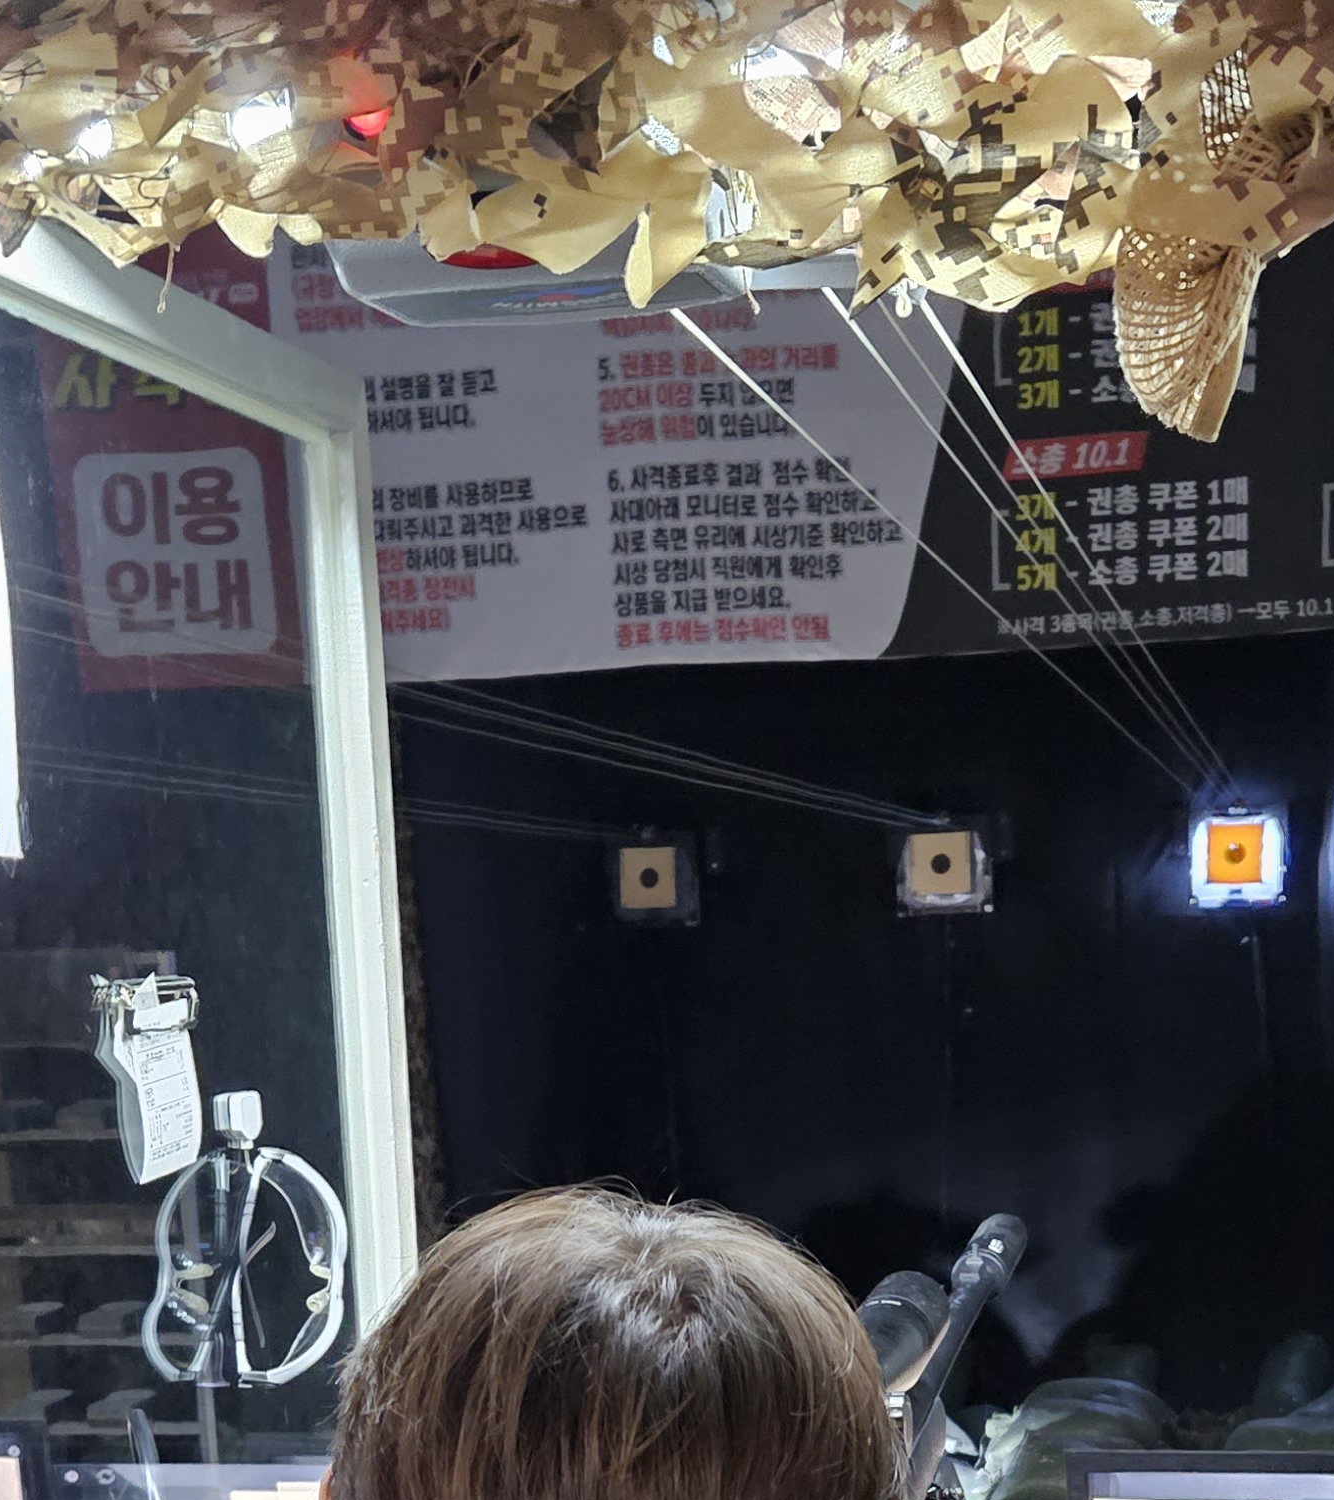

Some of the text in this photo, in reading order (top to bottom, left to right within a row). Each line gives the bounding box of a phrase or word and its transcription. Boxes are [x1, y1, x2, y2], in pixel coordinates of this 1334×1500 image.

[1018, 307, 1060, 337] 1개
[597, 357, 615, 381] 5.
[621, 350, 674, 379] 권총은
[783, 342, 839, 370] 거리를
[1017, 344, 1060, 374] 2개
[380, 372, 431, 401] 설명을
[437, 370, 454, 397] 잘
[462, 368, 498, 396] 듣고
[656, 381, 693, 409] 이상
[699, 381, 735, 406] 두지
[1018, 379, 1060, 410] 3개
[419, 403, 476, 430] 됩니다.
[1072, 438, 1131, 470] 10.1
[608, 455, 851, 492] 6. 사격종료후 결과 점수 확인
[101, 466, 242, 546] 이용
[389, 484, 439, 512] 장비를
[447, 477, 533, 507] 사용하므로
[610, 487, 879, 523] 사대아래 모니터로 점수 확인하고
[1086, 484, 1140, 517] 권총
[1147, 480, 1199, 511] 쿠폰
[1207, 476, 1249, 506] 1매
[459, 511, 512, 537] 과격한
[518, 503, 588, 532] 사용으로
[612, 517, 904, 554] 사로 측면 유리에 시상기준 확인하고
[1015, 513, 1249, 555] 4개 권총 쿠폰 2매
[462, 541, 520, 569] 됩니다.
[614, 553, 843, 586] 시상 당첨시 직원에게 확인후
[1017, 549, 1249, 591] 5개 소총 쿠폰 2매
[105, 559, 253, 633] 안내
[423, 574, 476, 601] 장전시
[616, 586, 791, 617] 상품을 지급 받으세요.
[1297, 598, 1334, 617] 10.1
[616, 621, 652, 648] 종료
[716, 616, 787, 643] 점수확인
